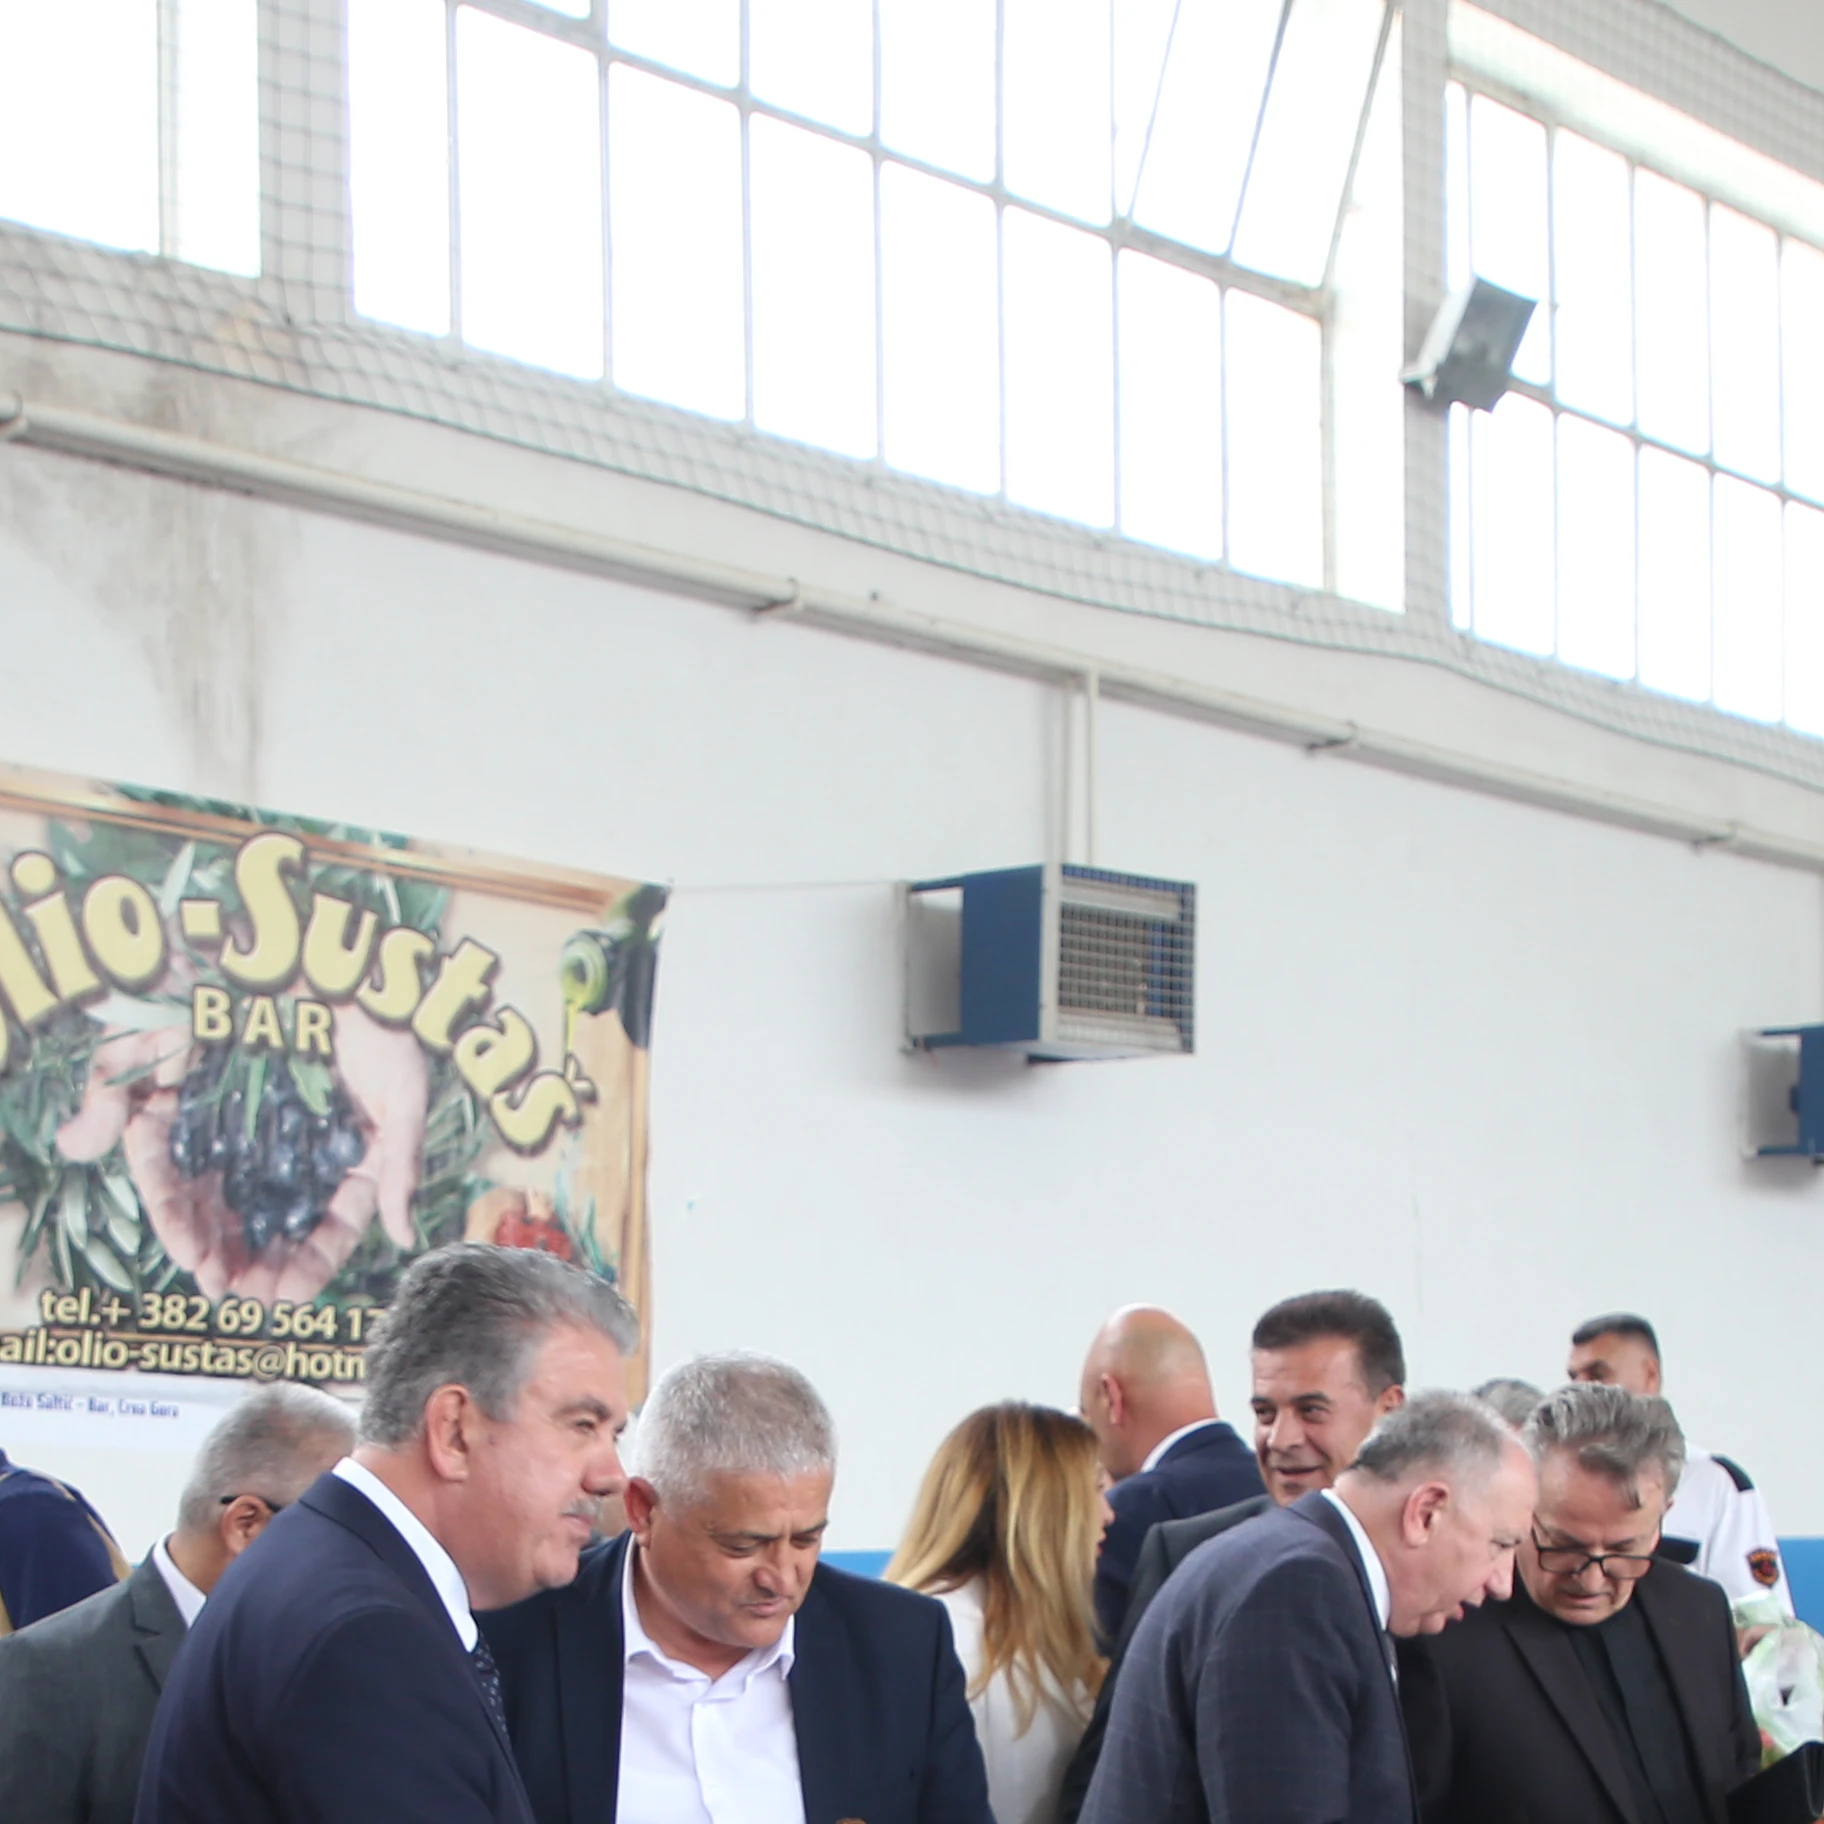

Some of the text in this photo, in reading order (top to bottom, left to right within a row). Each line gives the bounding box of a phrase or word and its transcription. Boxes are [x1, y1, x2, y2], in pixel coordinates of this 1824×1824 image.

[192, 985, 333, 1056] BAR
[137, 1291, 209, 1333] 382
[217, 1298, 261, 1335] 69
[268, 1300, 338, 1340] 564
